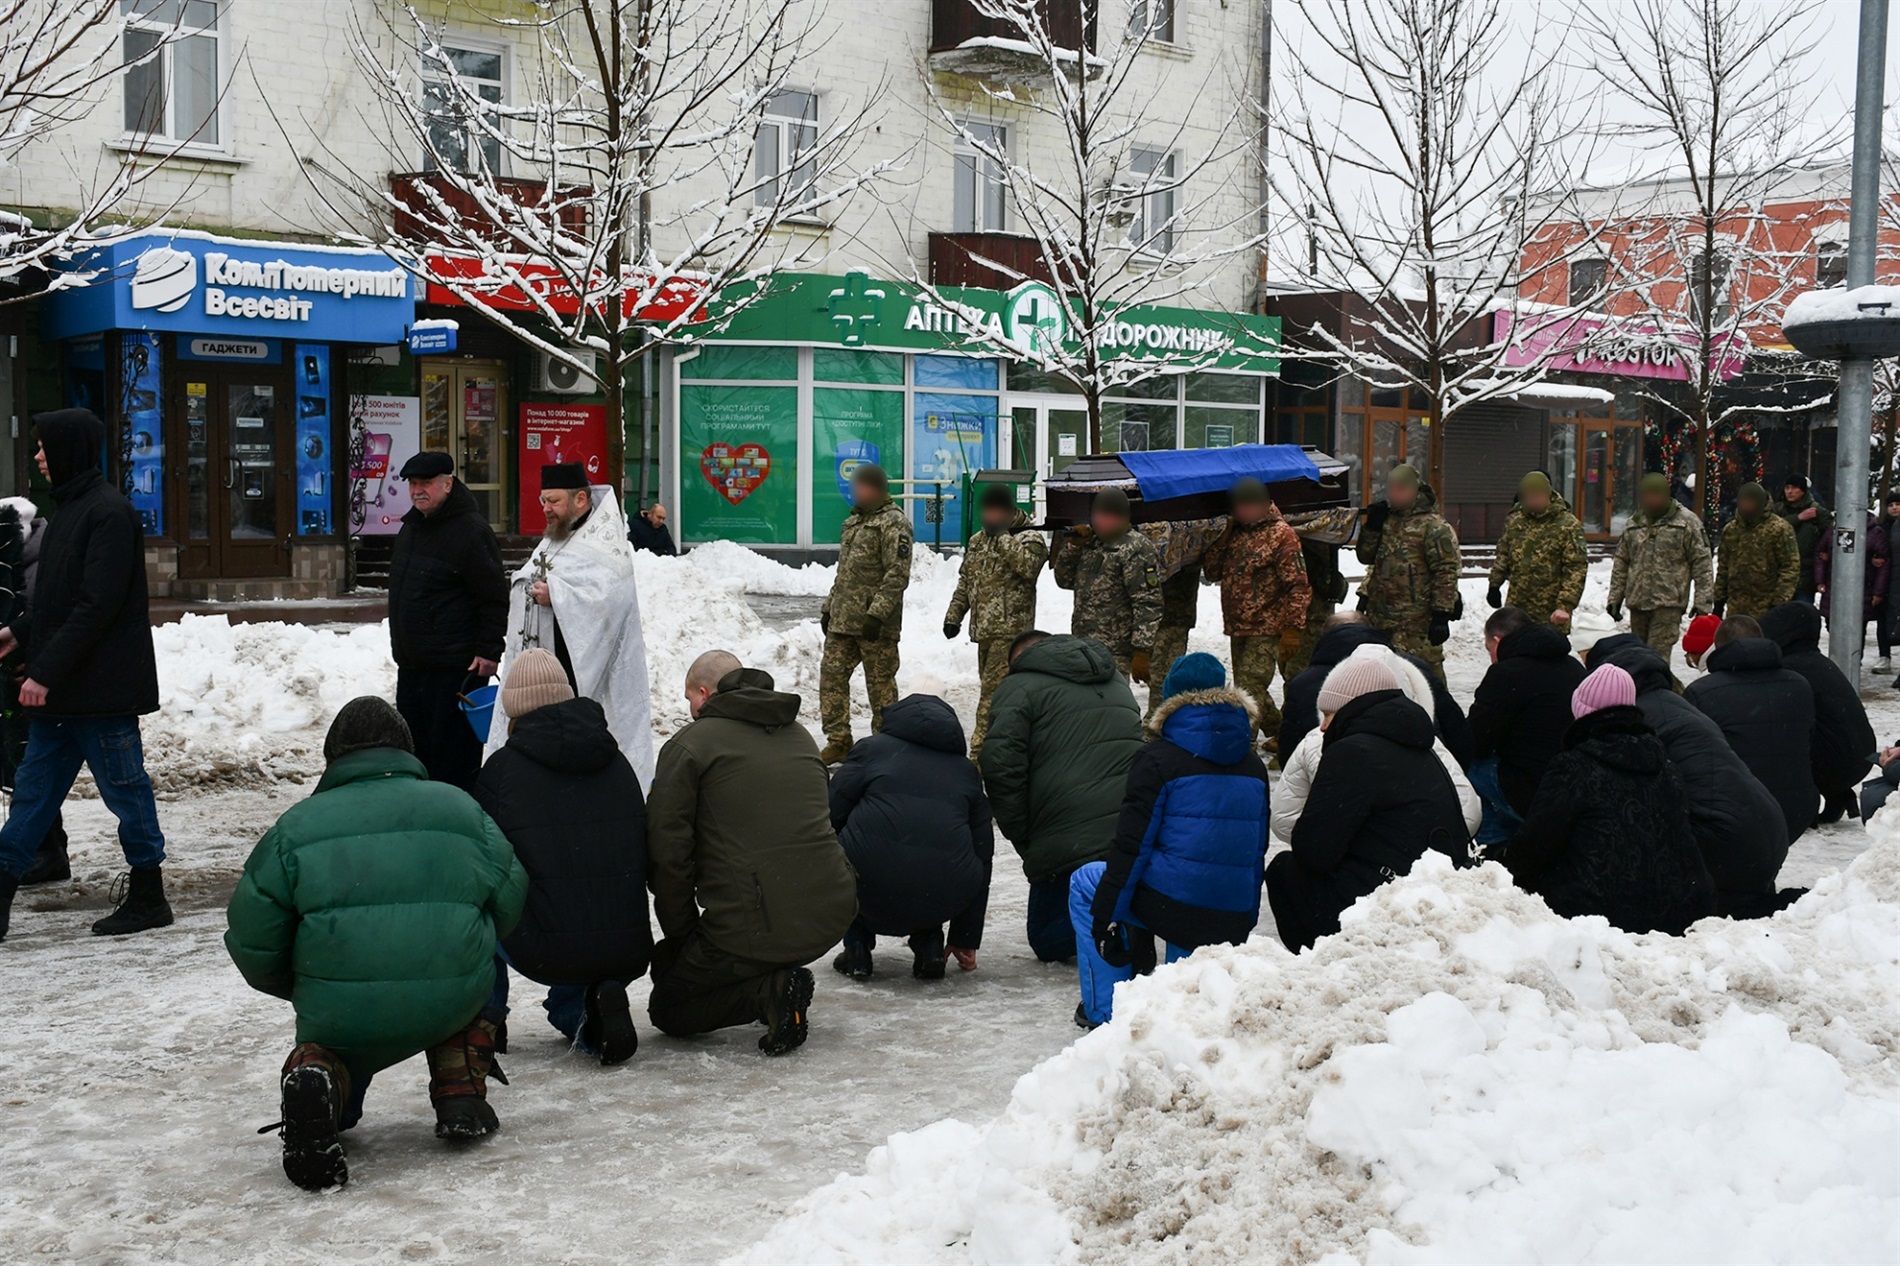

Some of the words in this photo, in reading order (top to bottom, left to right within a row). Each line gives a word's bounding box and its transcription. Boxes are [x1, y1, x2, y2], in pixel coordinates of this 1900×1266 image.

[205, 287, 313, 322] Всесвіт
[202, 342, 258, 356] ГАДЖЕТИ
[701, 403, 770, 412] СКОРИСТАЙТЕСЯ
[370, 411, 400, 419] рахунок
[527, 409, 546, 417] Понад
[705, 413, 765, 421] СОЦІАЛЬНИМИ
[532, 418, 585, 426] інтернет-магазині
[700, 422, 755, 430] ПРОГРАМАМИ
[757, 423, 771, 431] ТУТ
[939, 416, 982, 431] Знижки
